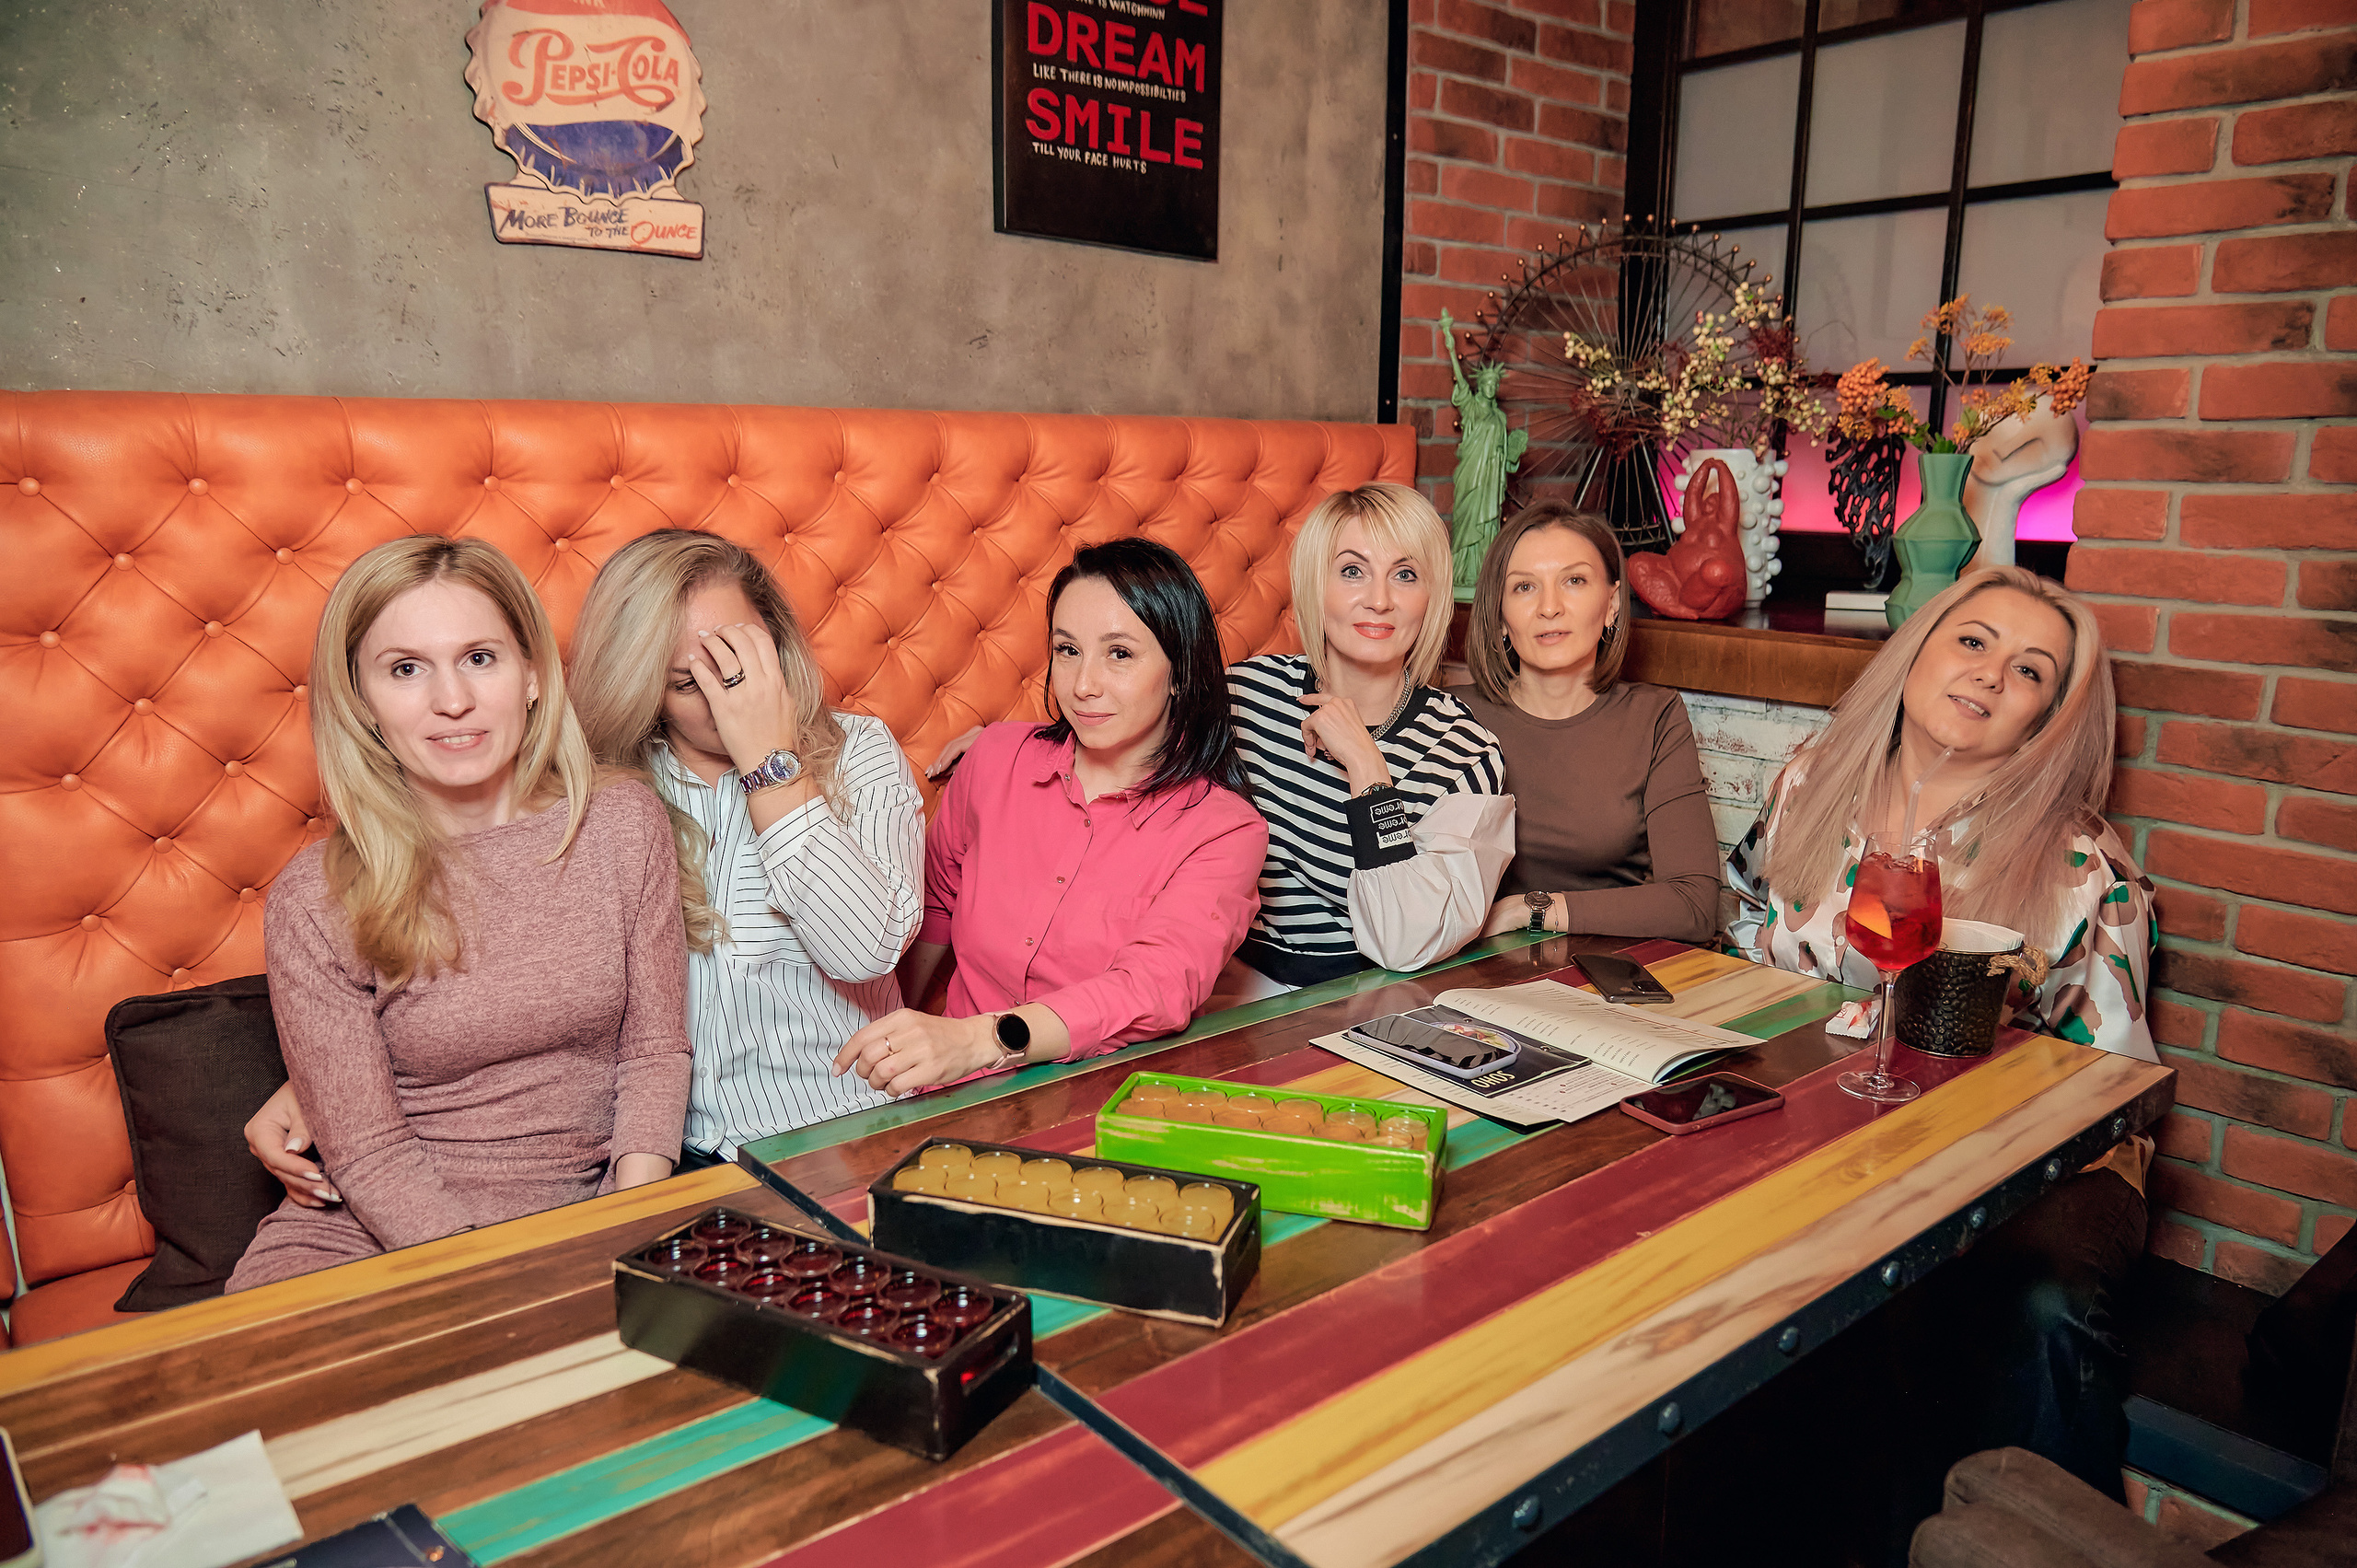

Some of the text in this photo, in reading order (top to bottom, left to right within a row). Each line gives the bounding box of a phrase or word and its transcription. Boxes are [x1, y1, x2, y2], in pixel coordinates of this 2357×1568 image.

[1027, 1, 1206, 93] DREAM
[1033, 63, 1056, 80] LIKE
[1059, 68, 1091, 86] THERE
[1093, 75, 1103, 88] IS
[1025, 87, 1204, 169] SMILE
[1032, 142, 1147, 174] TILL YOUR FACE HURTS
[499, 207, 629, 234] MORE BOUNCE
[586, 221, 698, 245] TO THE OUNCE
[1470, 1070, 1515, 1088] SOHO
